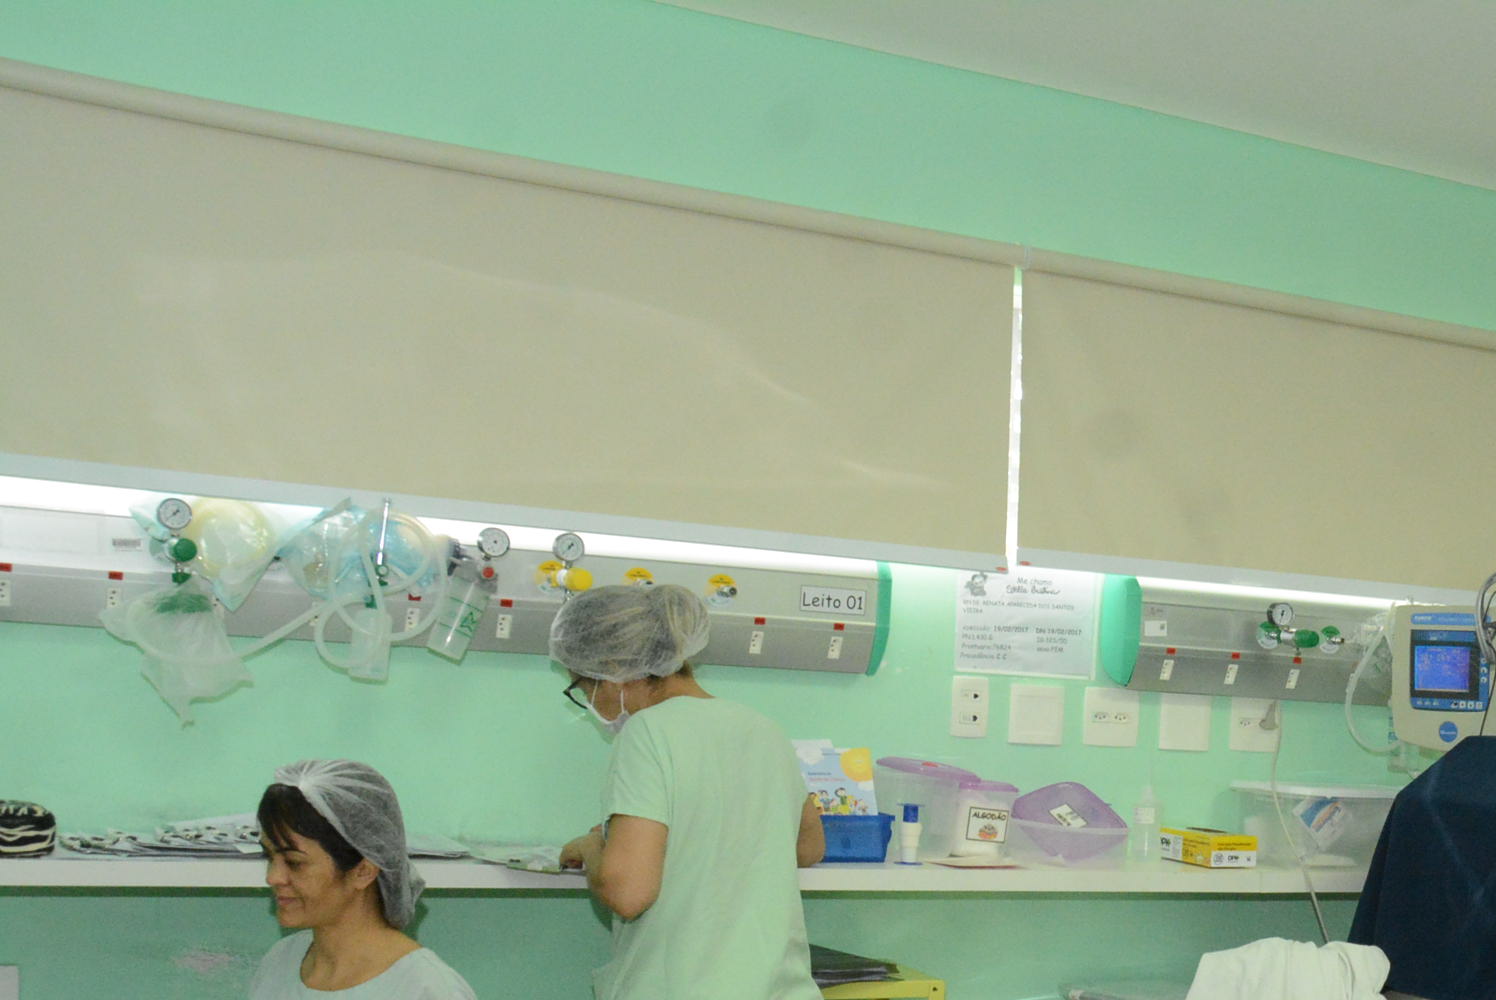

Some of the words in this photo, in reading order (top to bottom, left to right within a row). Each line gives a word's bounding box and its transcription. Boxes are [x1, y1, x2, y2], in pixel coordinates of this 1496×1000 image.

[802, 591, 841, 609] Leito
[846, 595, 863, 610] 01
[972, 811, 1007, 822] ALGODÃO
